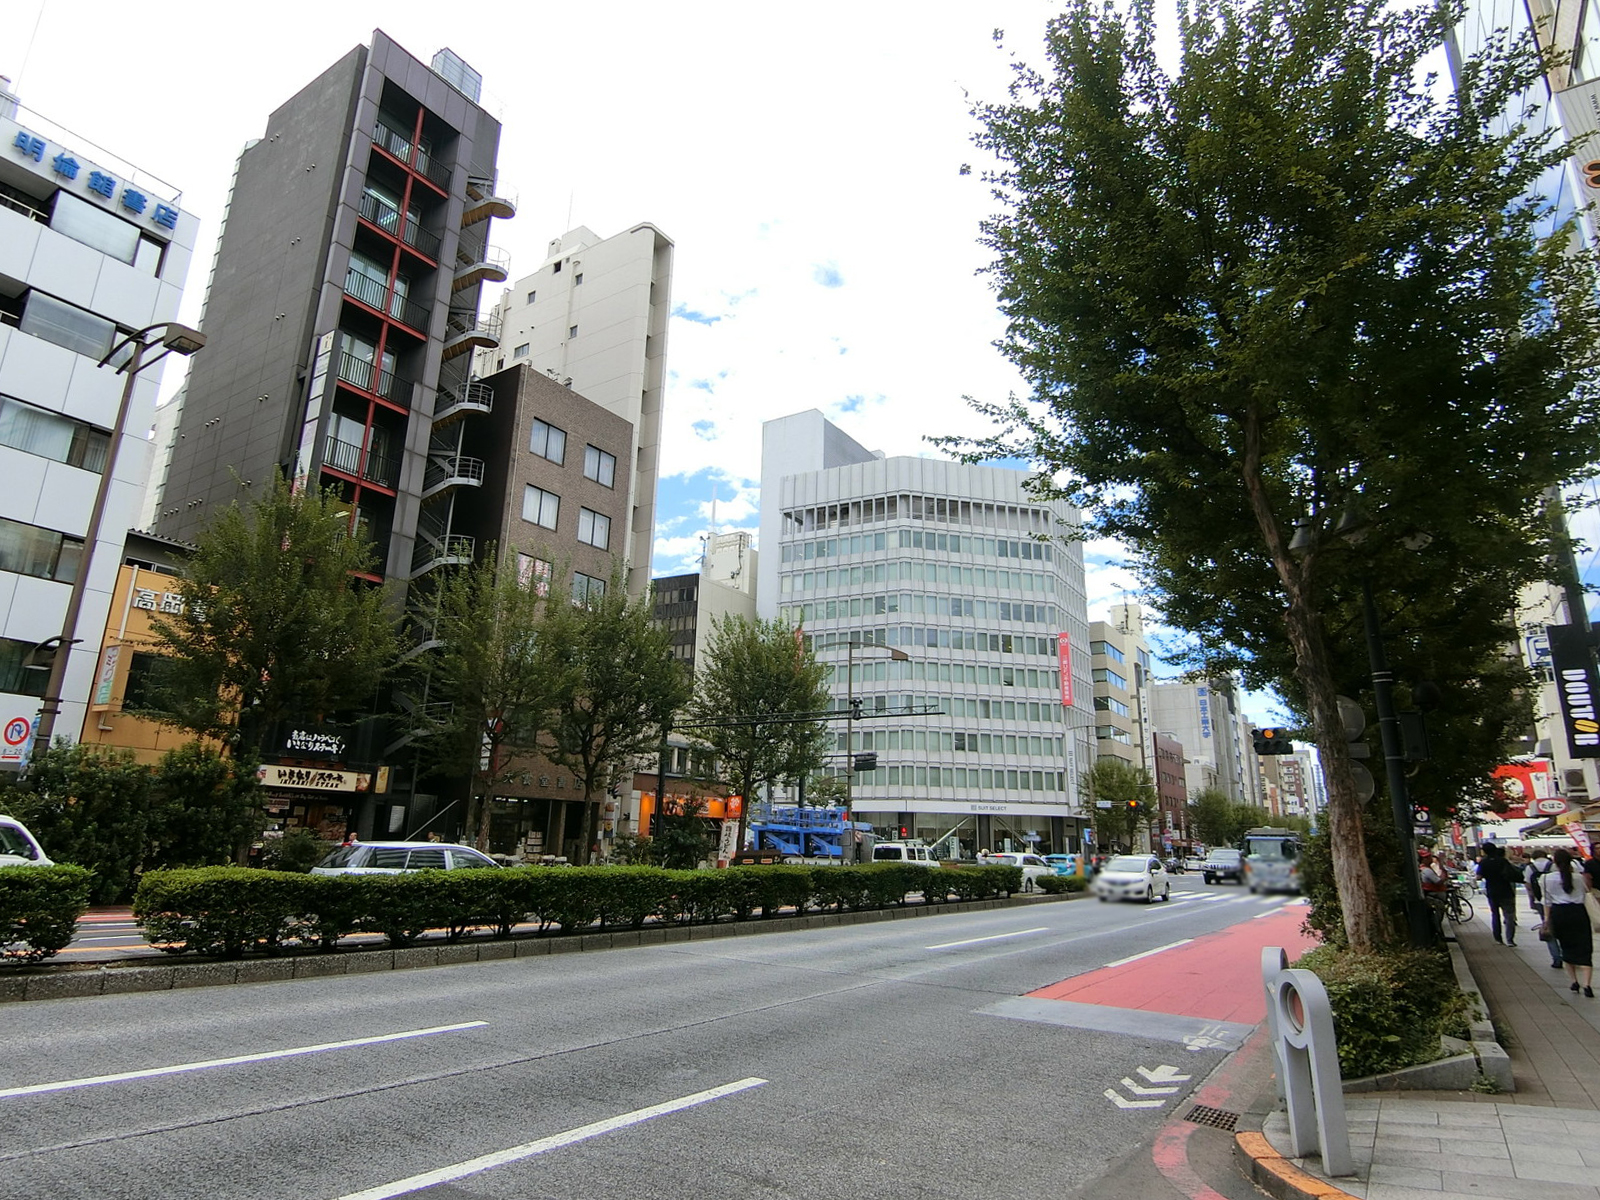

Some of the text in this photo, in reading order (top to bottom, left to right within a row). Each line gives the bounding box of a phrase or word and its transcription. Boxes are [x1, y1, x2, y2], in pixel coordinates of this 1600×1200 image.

[13, 130, 178, 230] 明倫館書店
[1561, 668, 1599, 746] DOUTOR
[277, 769, 344, 784] いきなり ステーキ
